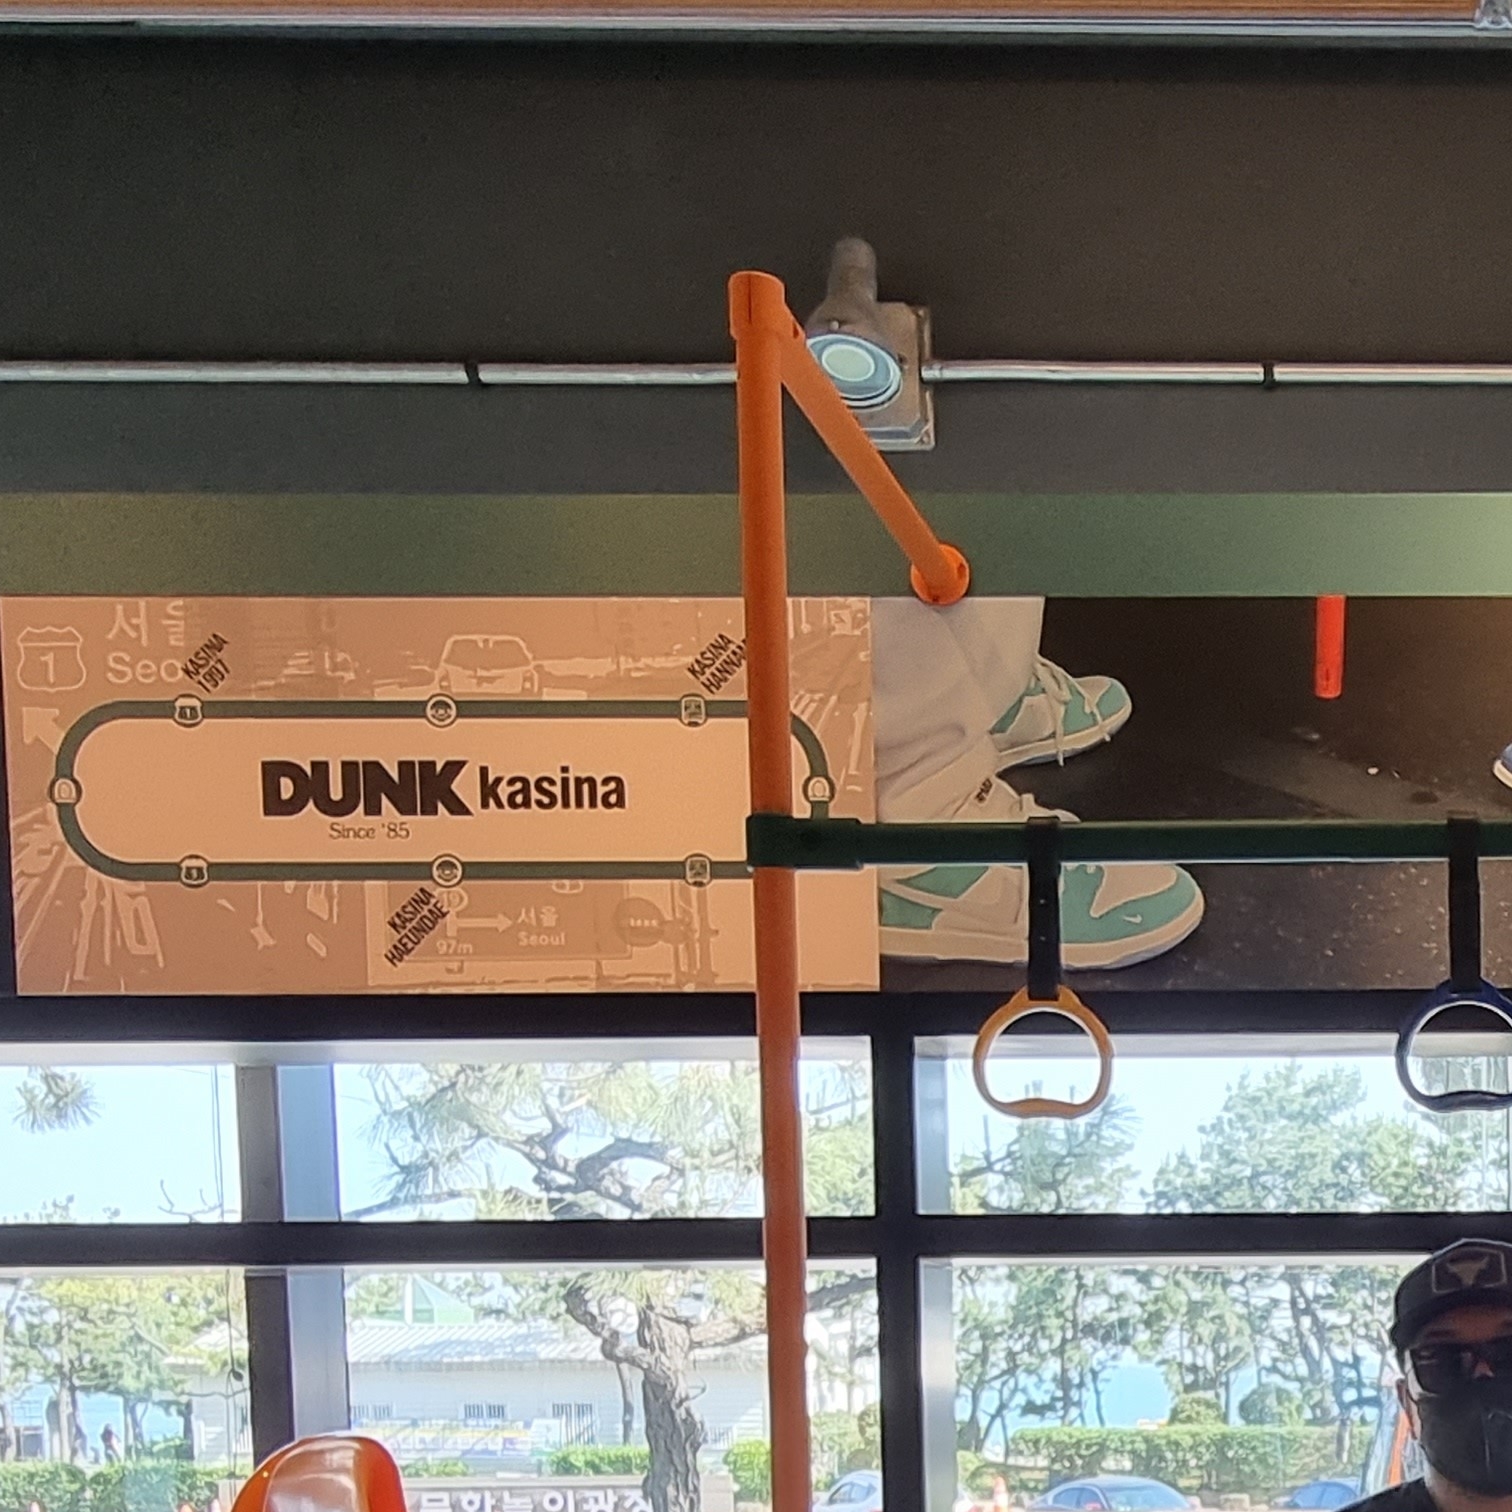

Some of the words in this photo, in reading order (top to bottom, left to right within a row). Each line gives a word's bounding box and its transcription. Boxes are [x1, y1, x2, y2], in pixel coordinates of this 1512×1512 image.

[181, 633, 229, 680] KASINA
[687, 633, 734, 680] KASINA
[261, 760, 474, 817] DUNK
[479, 766, 625, 810] kasina
[329, 822, 376, 840] Since
[384, 900, 450, 968] HAEUNDAE
[387, 887, 436, 935] KASINA
[436, 939, 473, 954] 97m
[518, 931, 566, 946] Seoul
